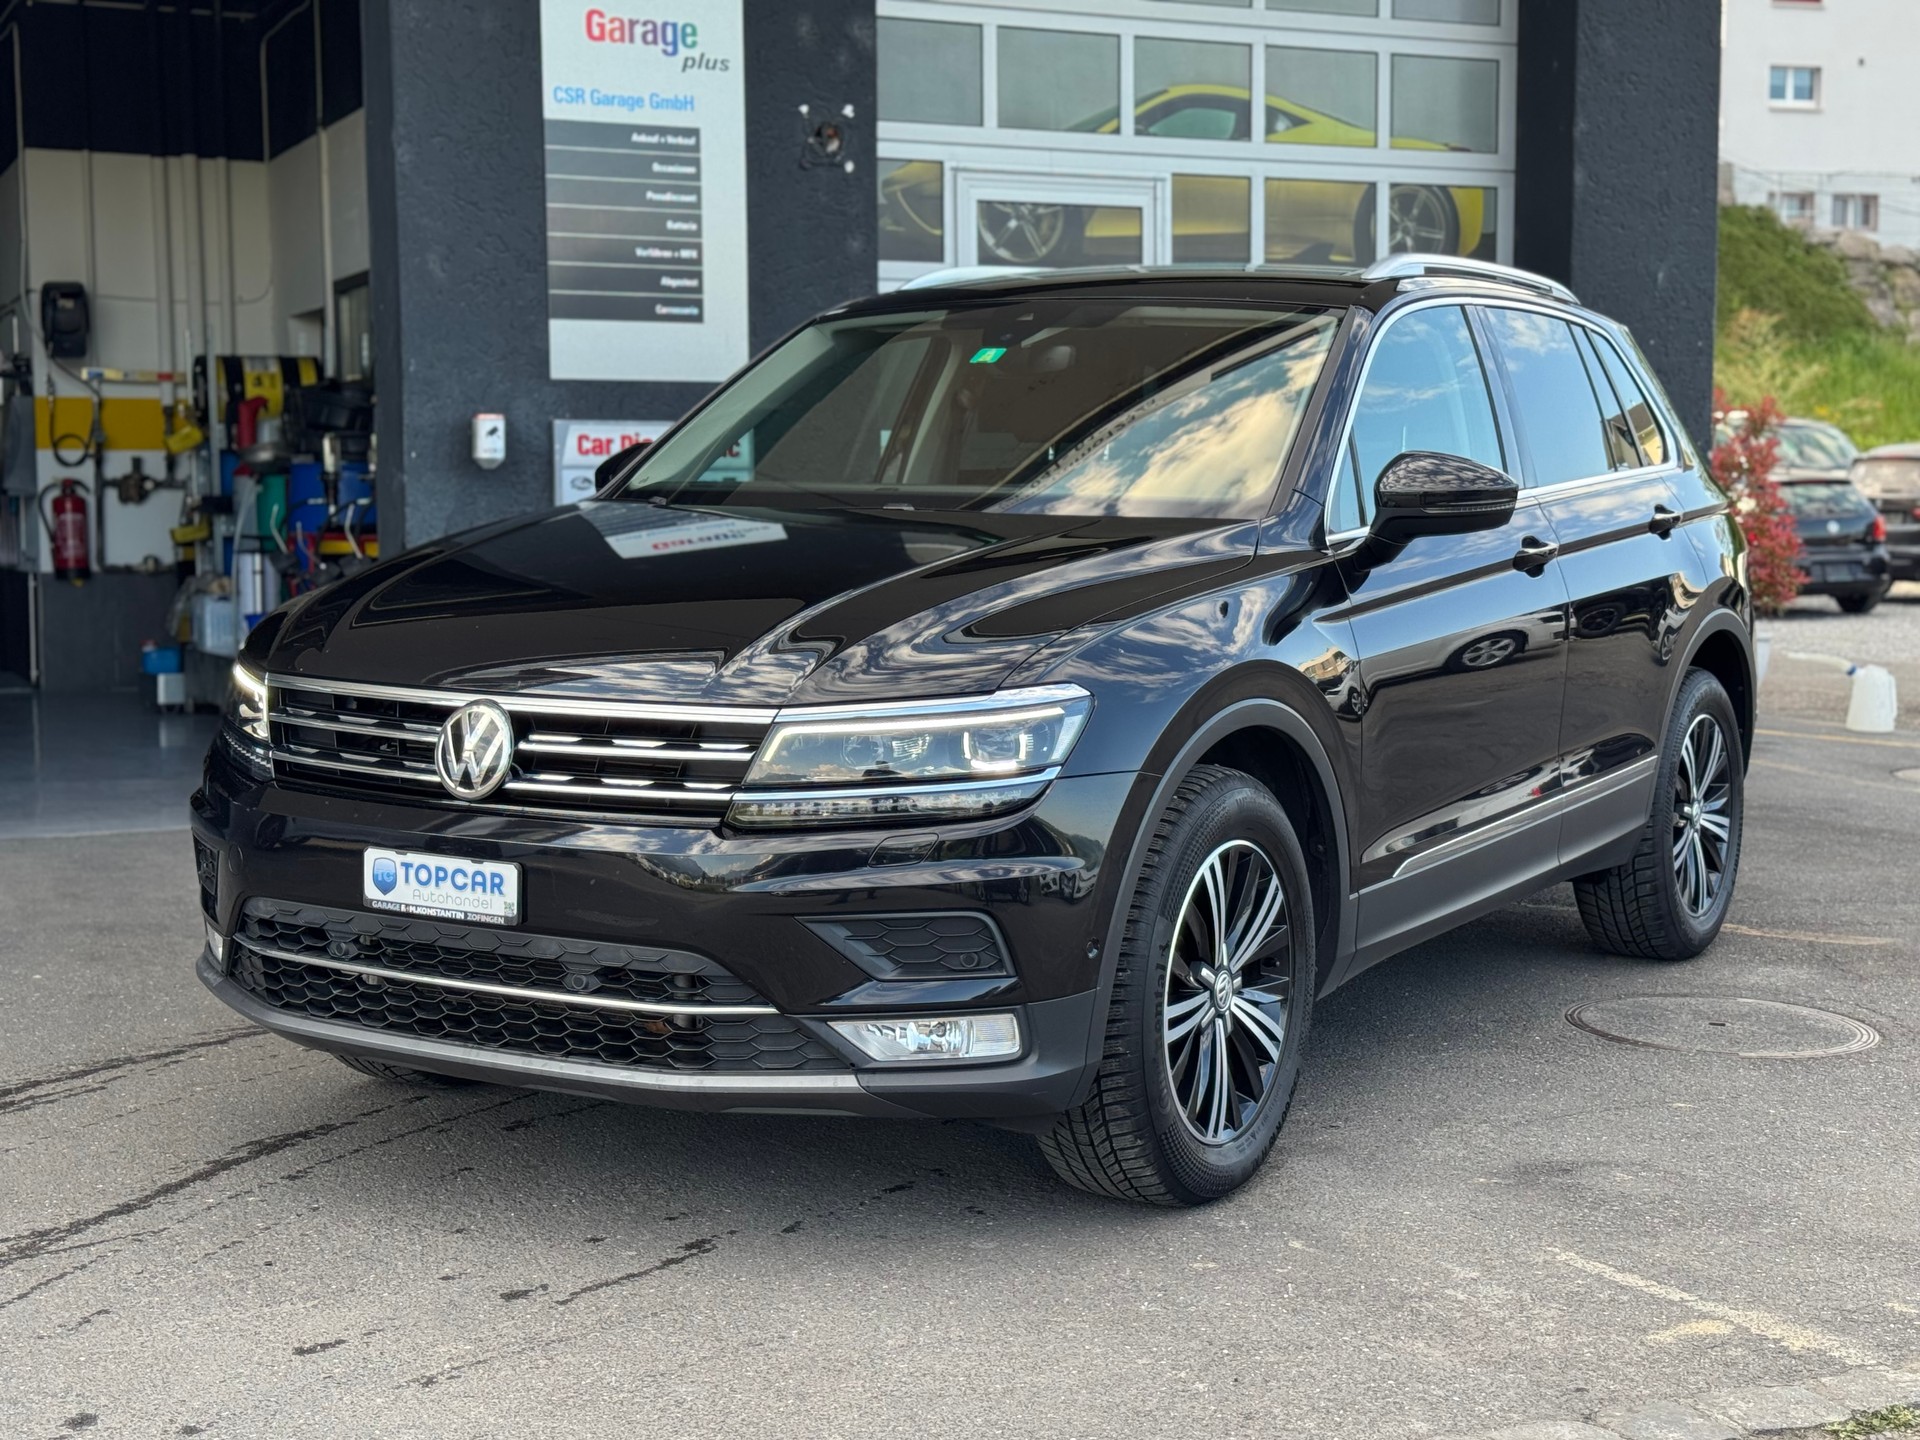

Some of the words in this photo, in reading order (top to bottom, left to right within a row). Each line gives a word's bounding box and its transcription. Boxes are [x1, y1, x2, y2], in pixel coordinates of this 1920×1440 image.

[585, 9, 699, 56] Garage
[680, 52, 731, 73] plus
[553, 85, 586, 105] CSR
[589, 90, 645, 113] Garage
[648, 92, 695, 111] GmbH
[577, 433, 613, 456] Car
[400, 861, 505, 896] TOPCAR
[412, 888, 493, 909] Autohandel
[372, 900, 401, 912] GARAGE
[466, 912, 505, 926] ZOFINGEN
